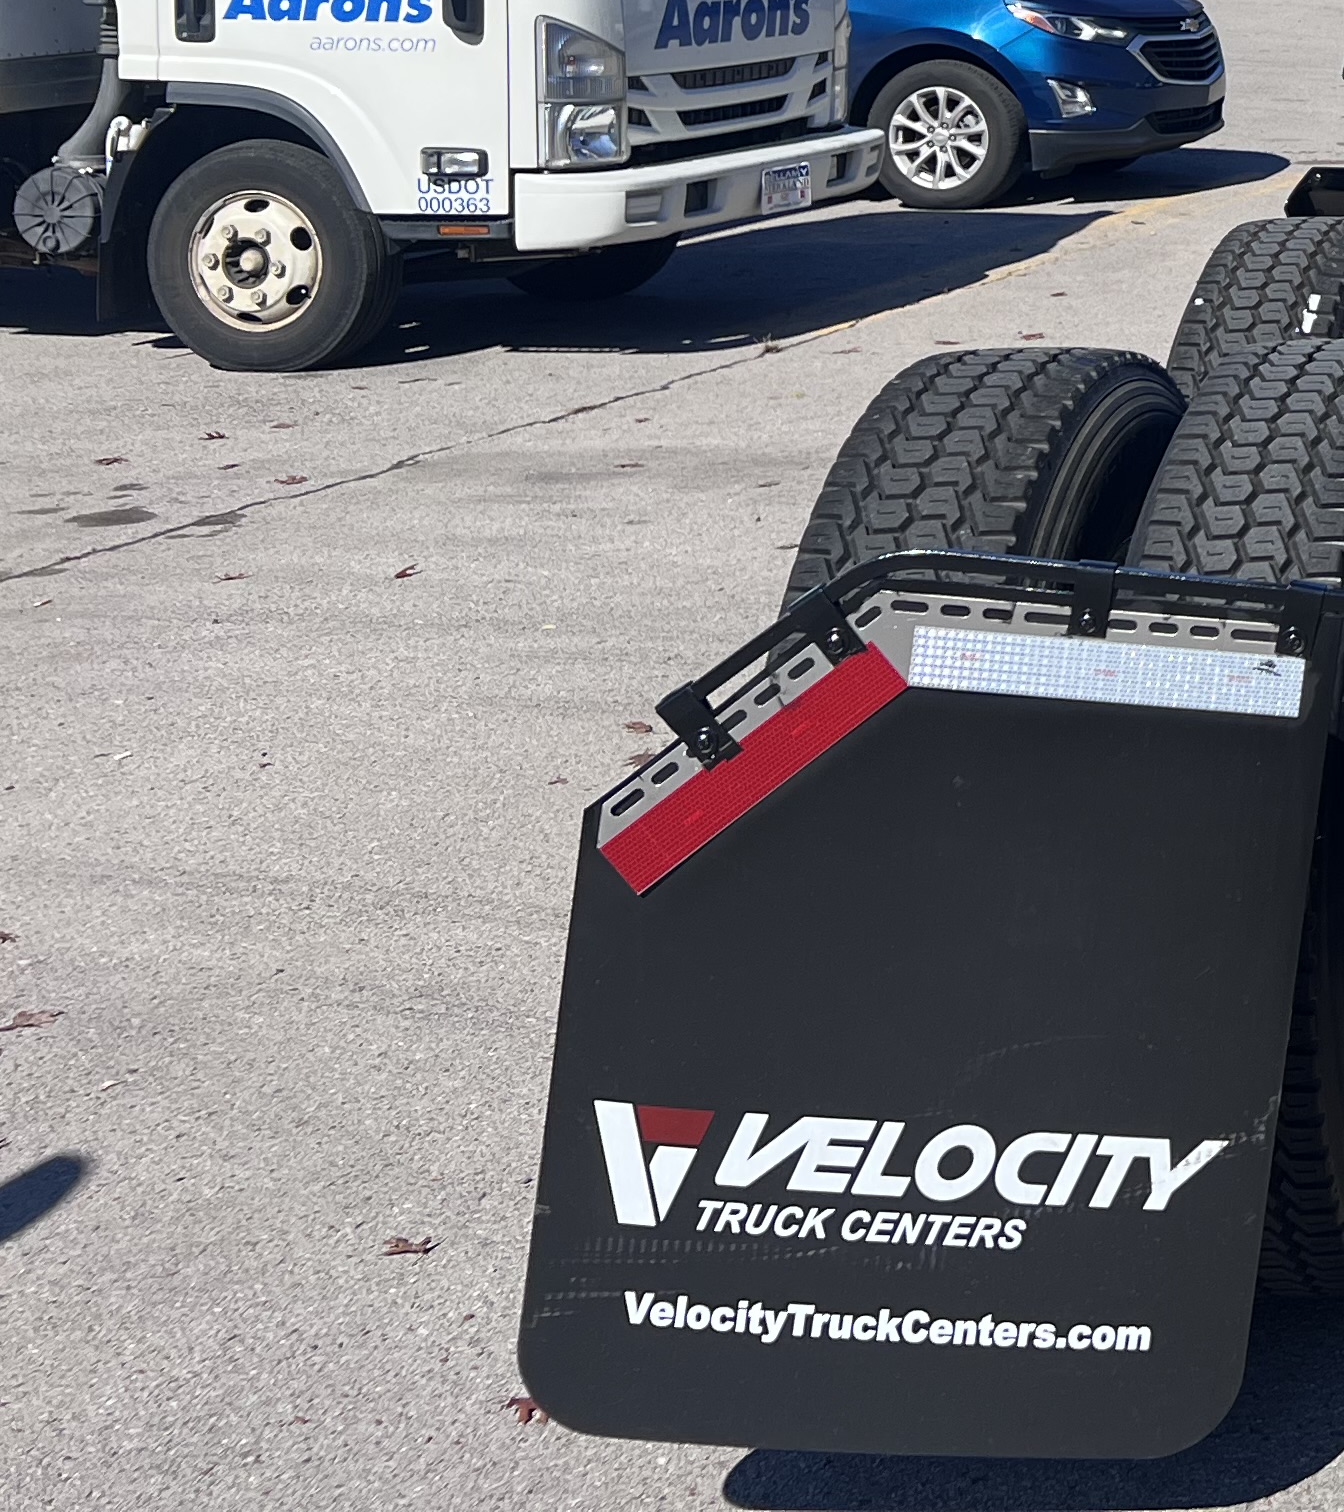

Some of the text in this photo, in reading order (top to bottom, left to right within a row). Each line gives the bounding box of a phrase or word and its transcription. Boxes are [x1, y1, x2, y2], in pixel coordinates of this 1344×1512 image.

[309, 36, 437, 53] aarons.com
[417, 178, 494, 195] USDOT
[418, 196, 491, 213] 000363
[714, 1112, 1230, 1211] VELOCITY
[696, 1199, 1028, 1250] TRUCK CENTERS
[623, 1290, 1152, 1352] VelocityTruckCenters.com
